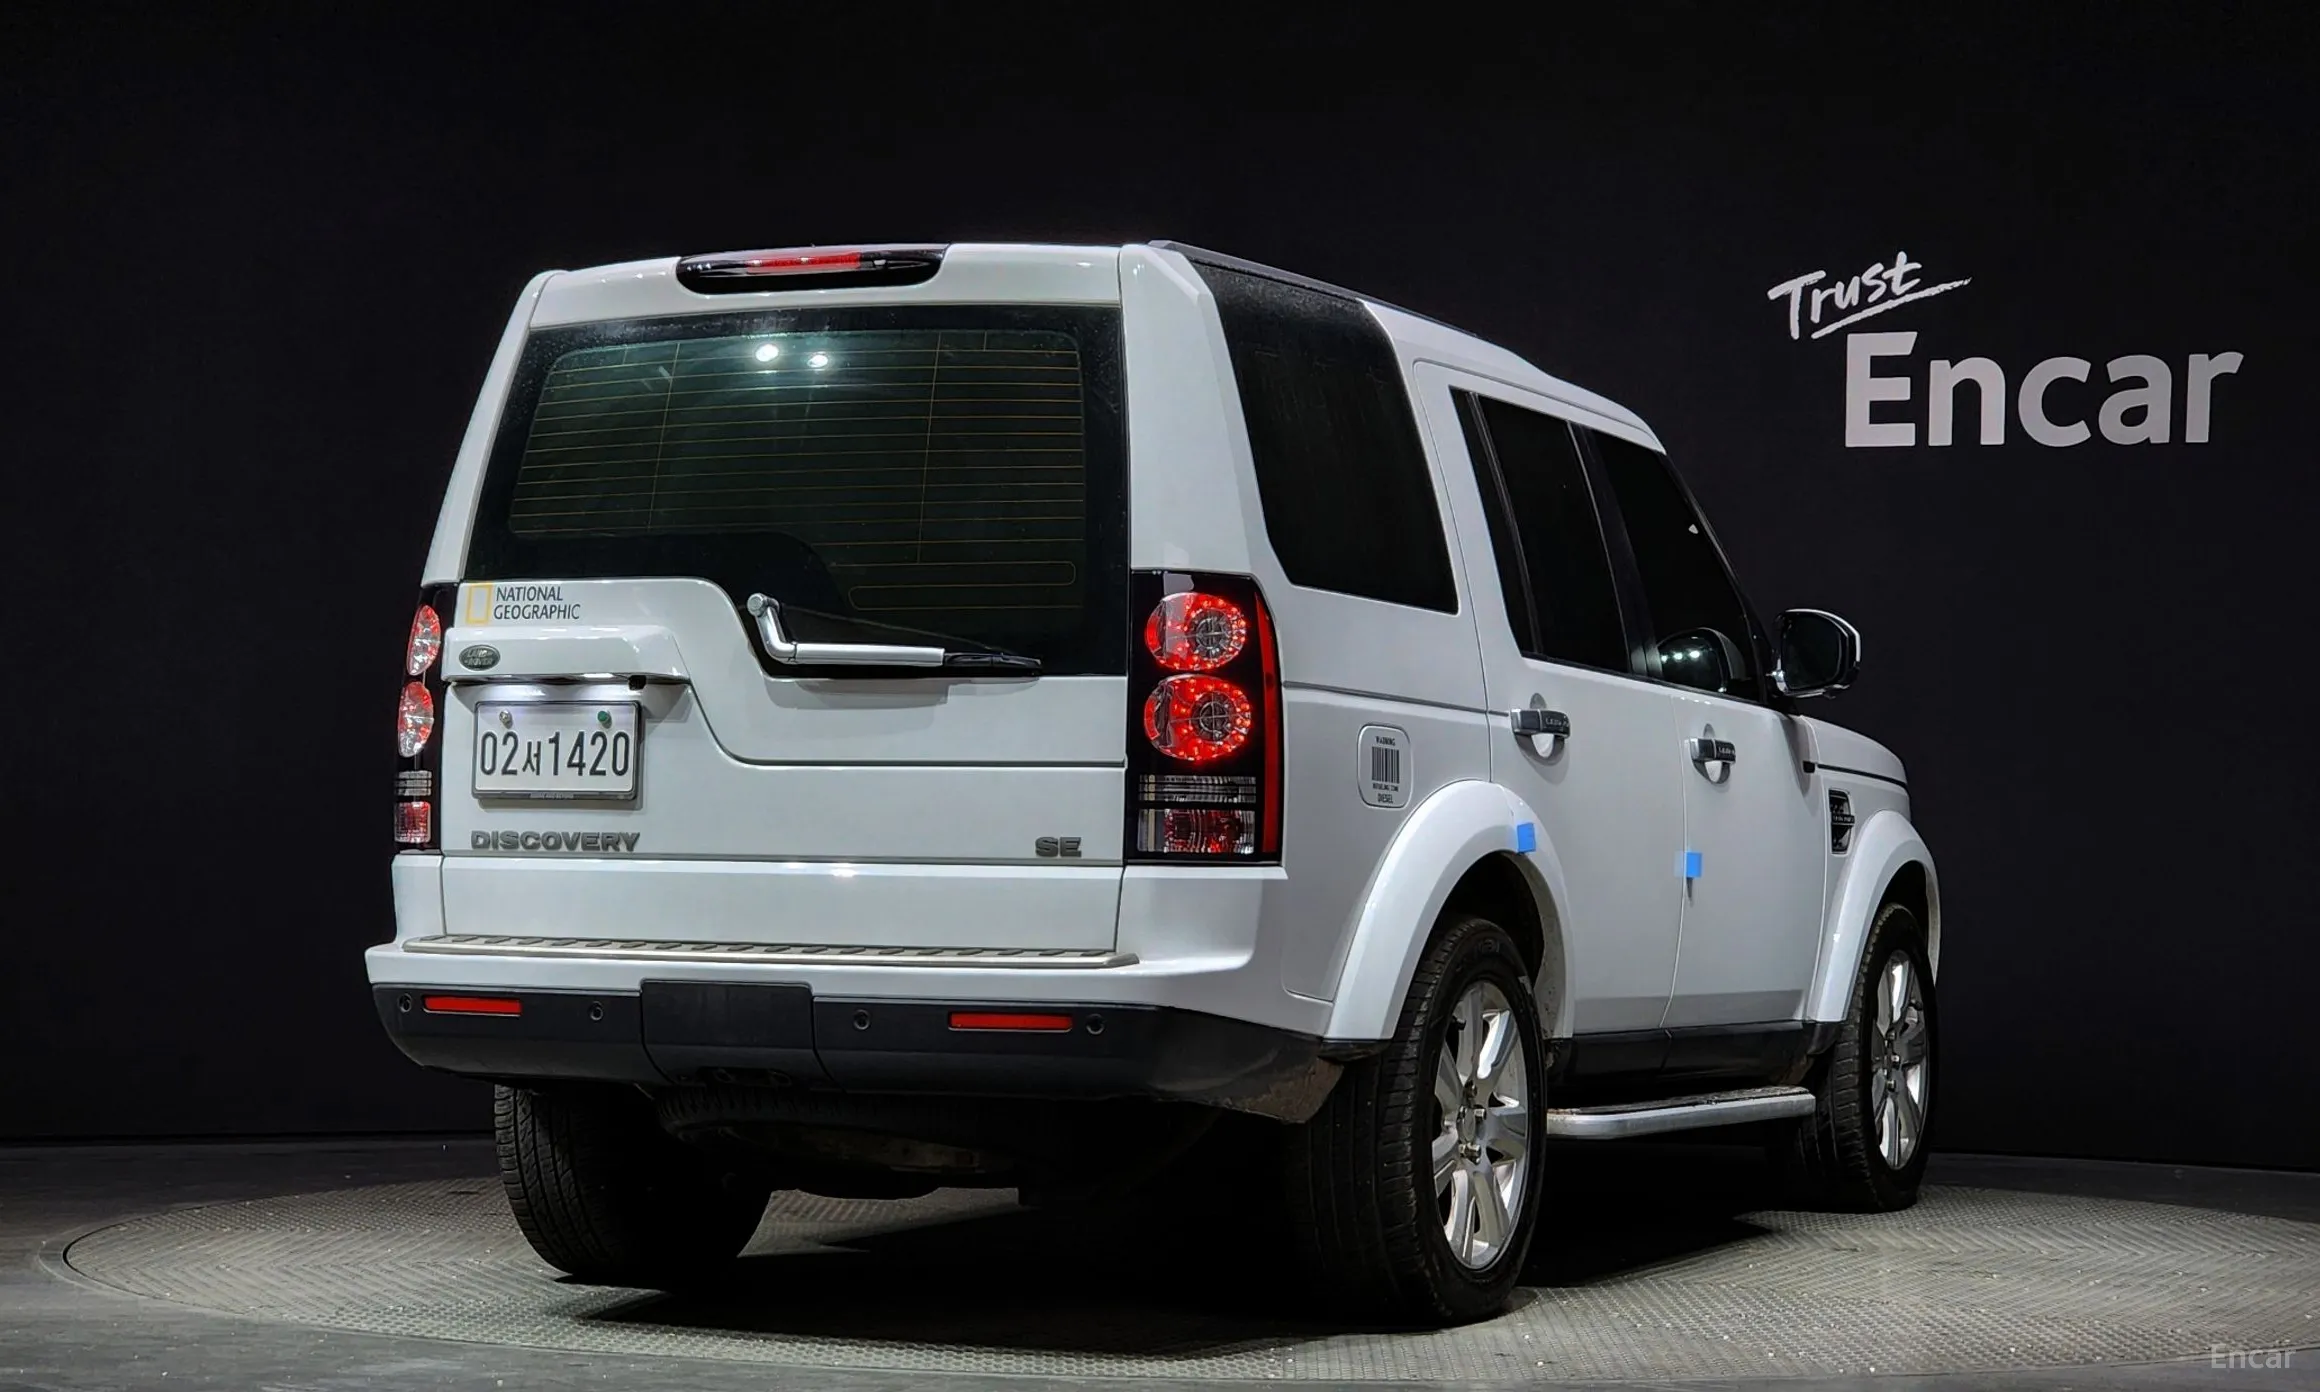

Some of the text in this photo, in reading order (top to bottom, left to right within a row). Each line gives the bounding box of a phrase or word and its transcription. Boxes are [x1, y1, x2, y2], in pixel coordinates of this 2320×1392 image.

[1767, 250, 1922, 340] Trust
[1844, 330, 2244, 448] Encar
[496, 585, 564, 602] NATIONAL
[493, 603, 581, 620] GEOGRAPHIC
[480, 730, 631, 777] 02서1420
[470, 830, 641, 852] DISCOVERY
[1035, 836, 1082, 858] SE
